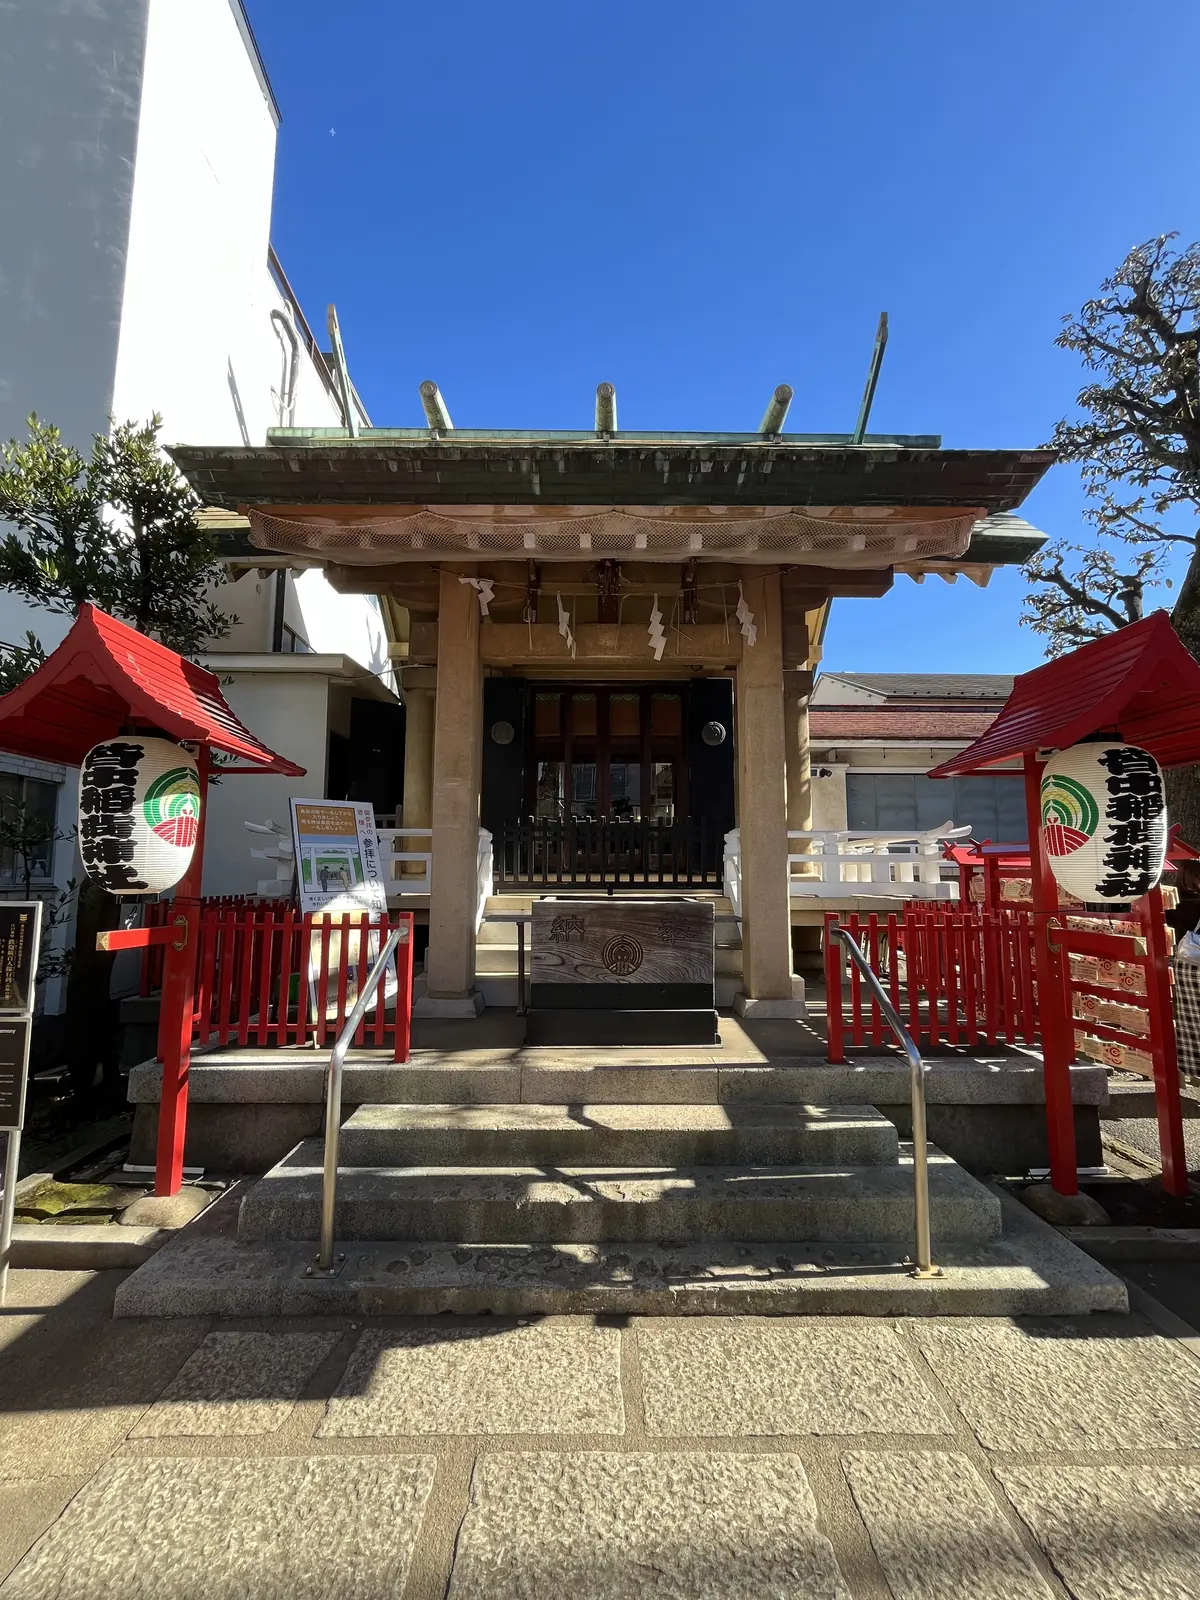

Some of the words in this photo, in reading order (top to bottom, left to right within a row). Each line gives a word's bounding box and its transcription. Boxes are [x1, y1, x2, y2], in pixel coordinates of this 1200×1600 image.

[80, 742, 149, 890] 皆中稲荷神社
[1095, 747, 1167, 898] 皆中稲荷神社
[549, 914, 586, 943] 納
